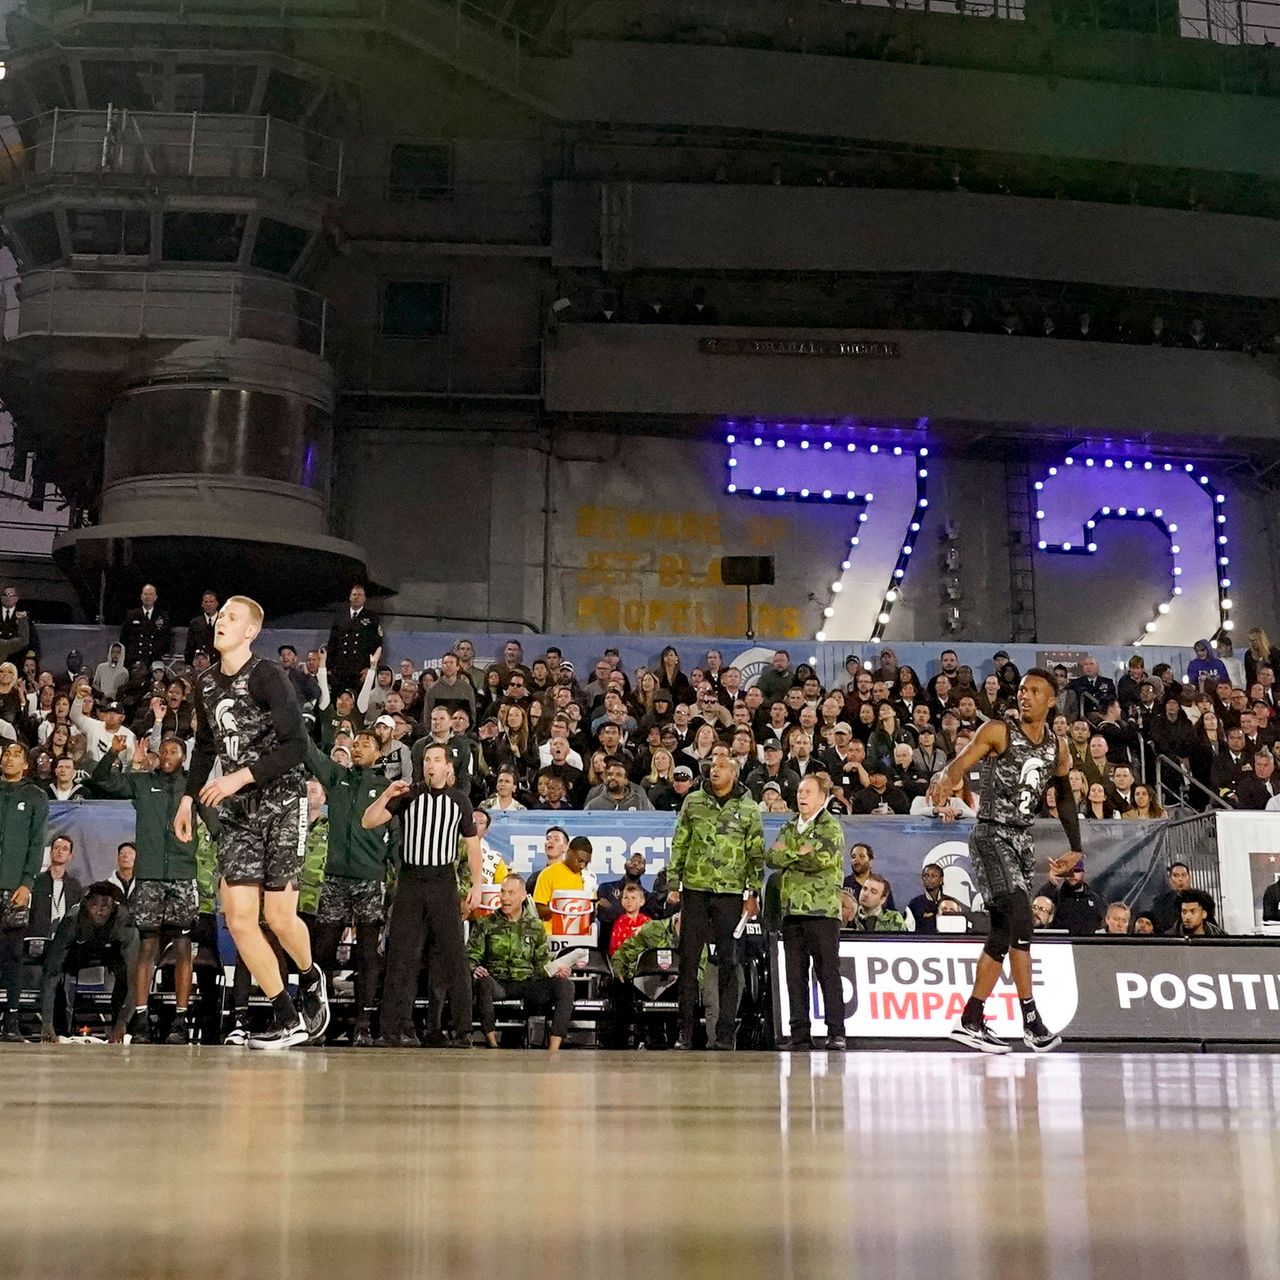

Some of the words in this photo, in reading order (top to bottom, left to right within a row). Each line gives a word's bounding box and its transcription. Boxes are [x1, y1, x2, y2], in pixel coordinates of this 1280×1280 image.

[656, 552, 723, 589] BLA
[222, 735, 240, 762] 10
[1019, 791, 1032, 815] 2
[296, 797, 309, 857] SPARTANS
[509, 835, 673, 874] FRC
[866, 957, 1045, 986] POSITE
